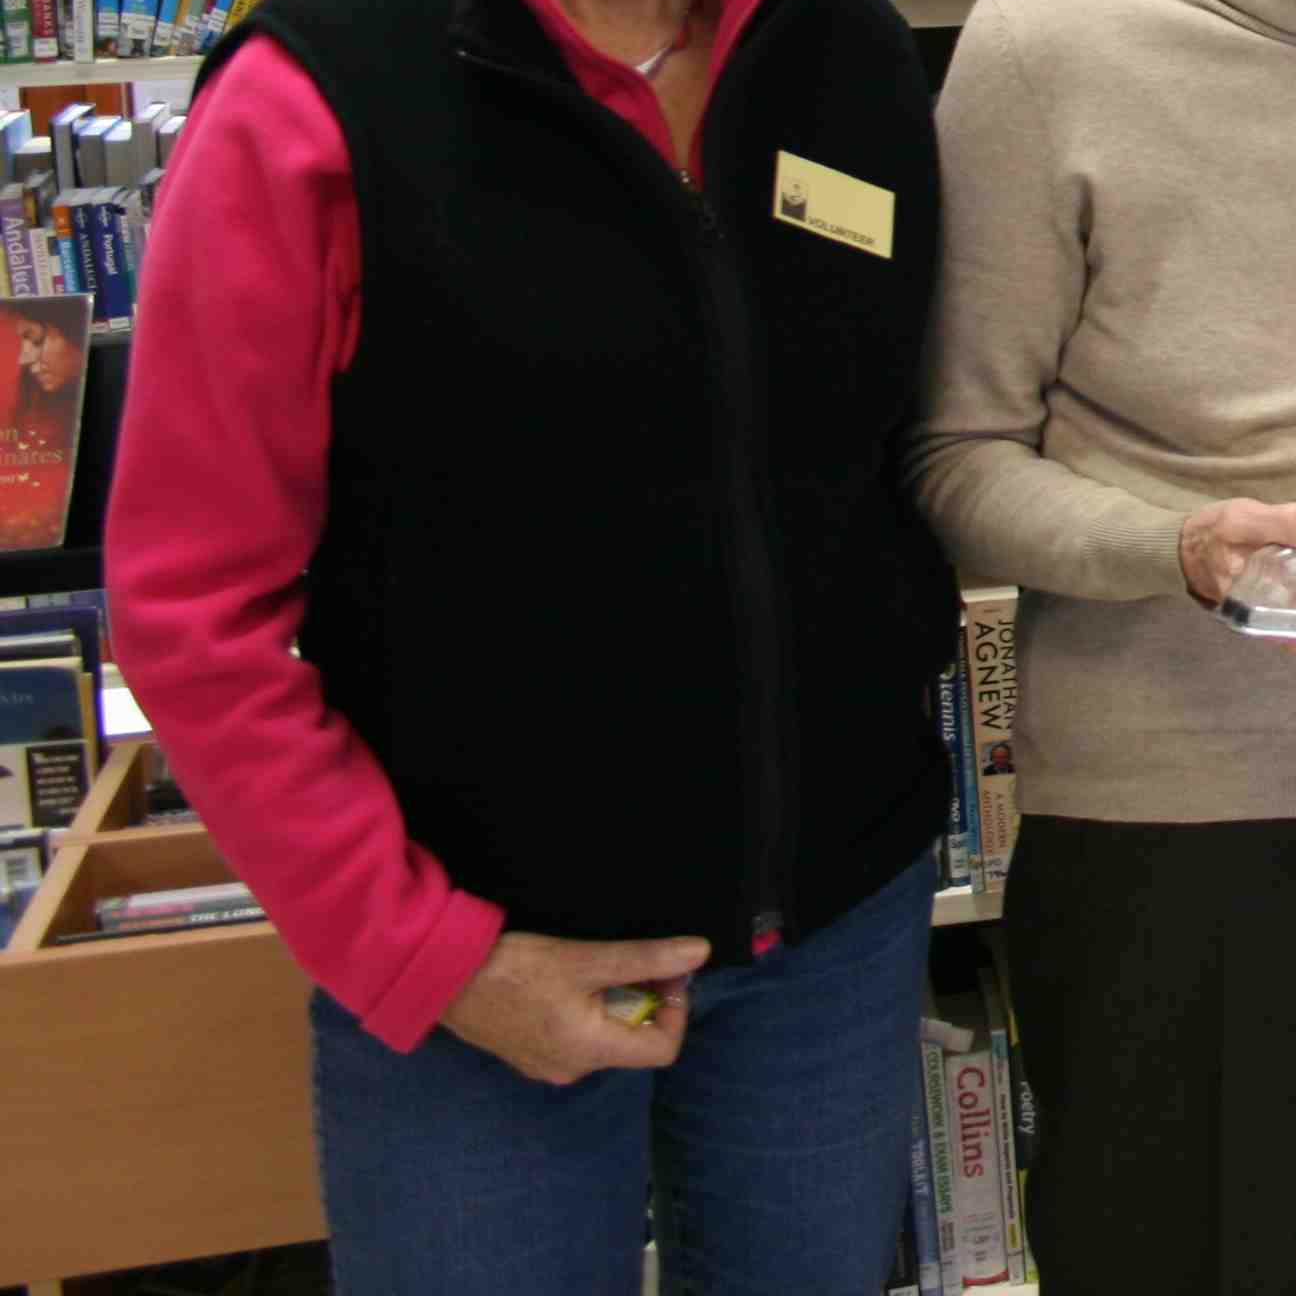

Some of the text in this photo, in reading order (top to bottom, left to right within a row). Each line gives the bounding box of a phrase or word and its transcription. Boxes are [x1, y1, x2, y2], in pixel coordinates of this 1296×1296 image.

[103, 232, 118, 275] Portugal
[975, 621, 1001, 731] AGNEW
[999, 618, 1018, 731] JONATHAN
[940, 683, 957, 742] tennis
[926, 1051, 944, 1128] COURSEWORK
[956, 1065, 991, 1179] Collins
[934, 1141, 948, 1174] EXAM
[937, 1175, 952, 1214] ESSAYS
